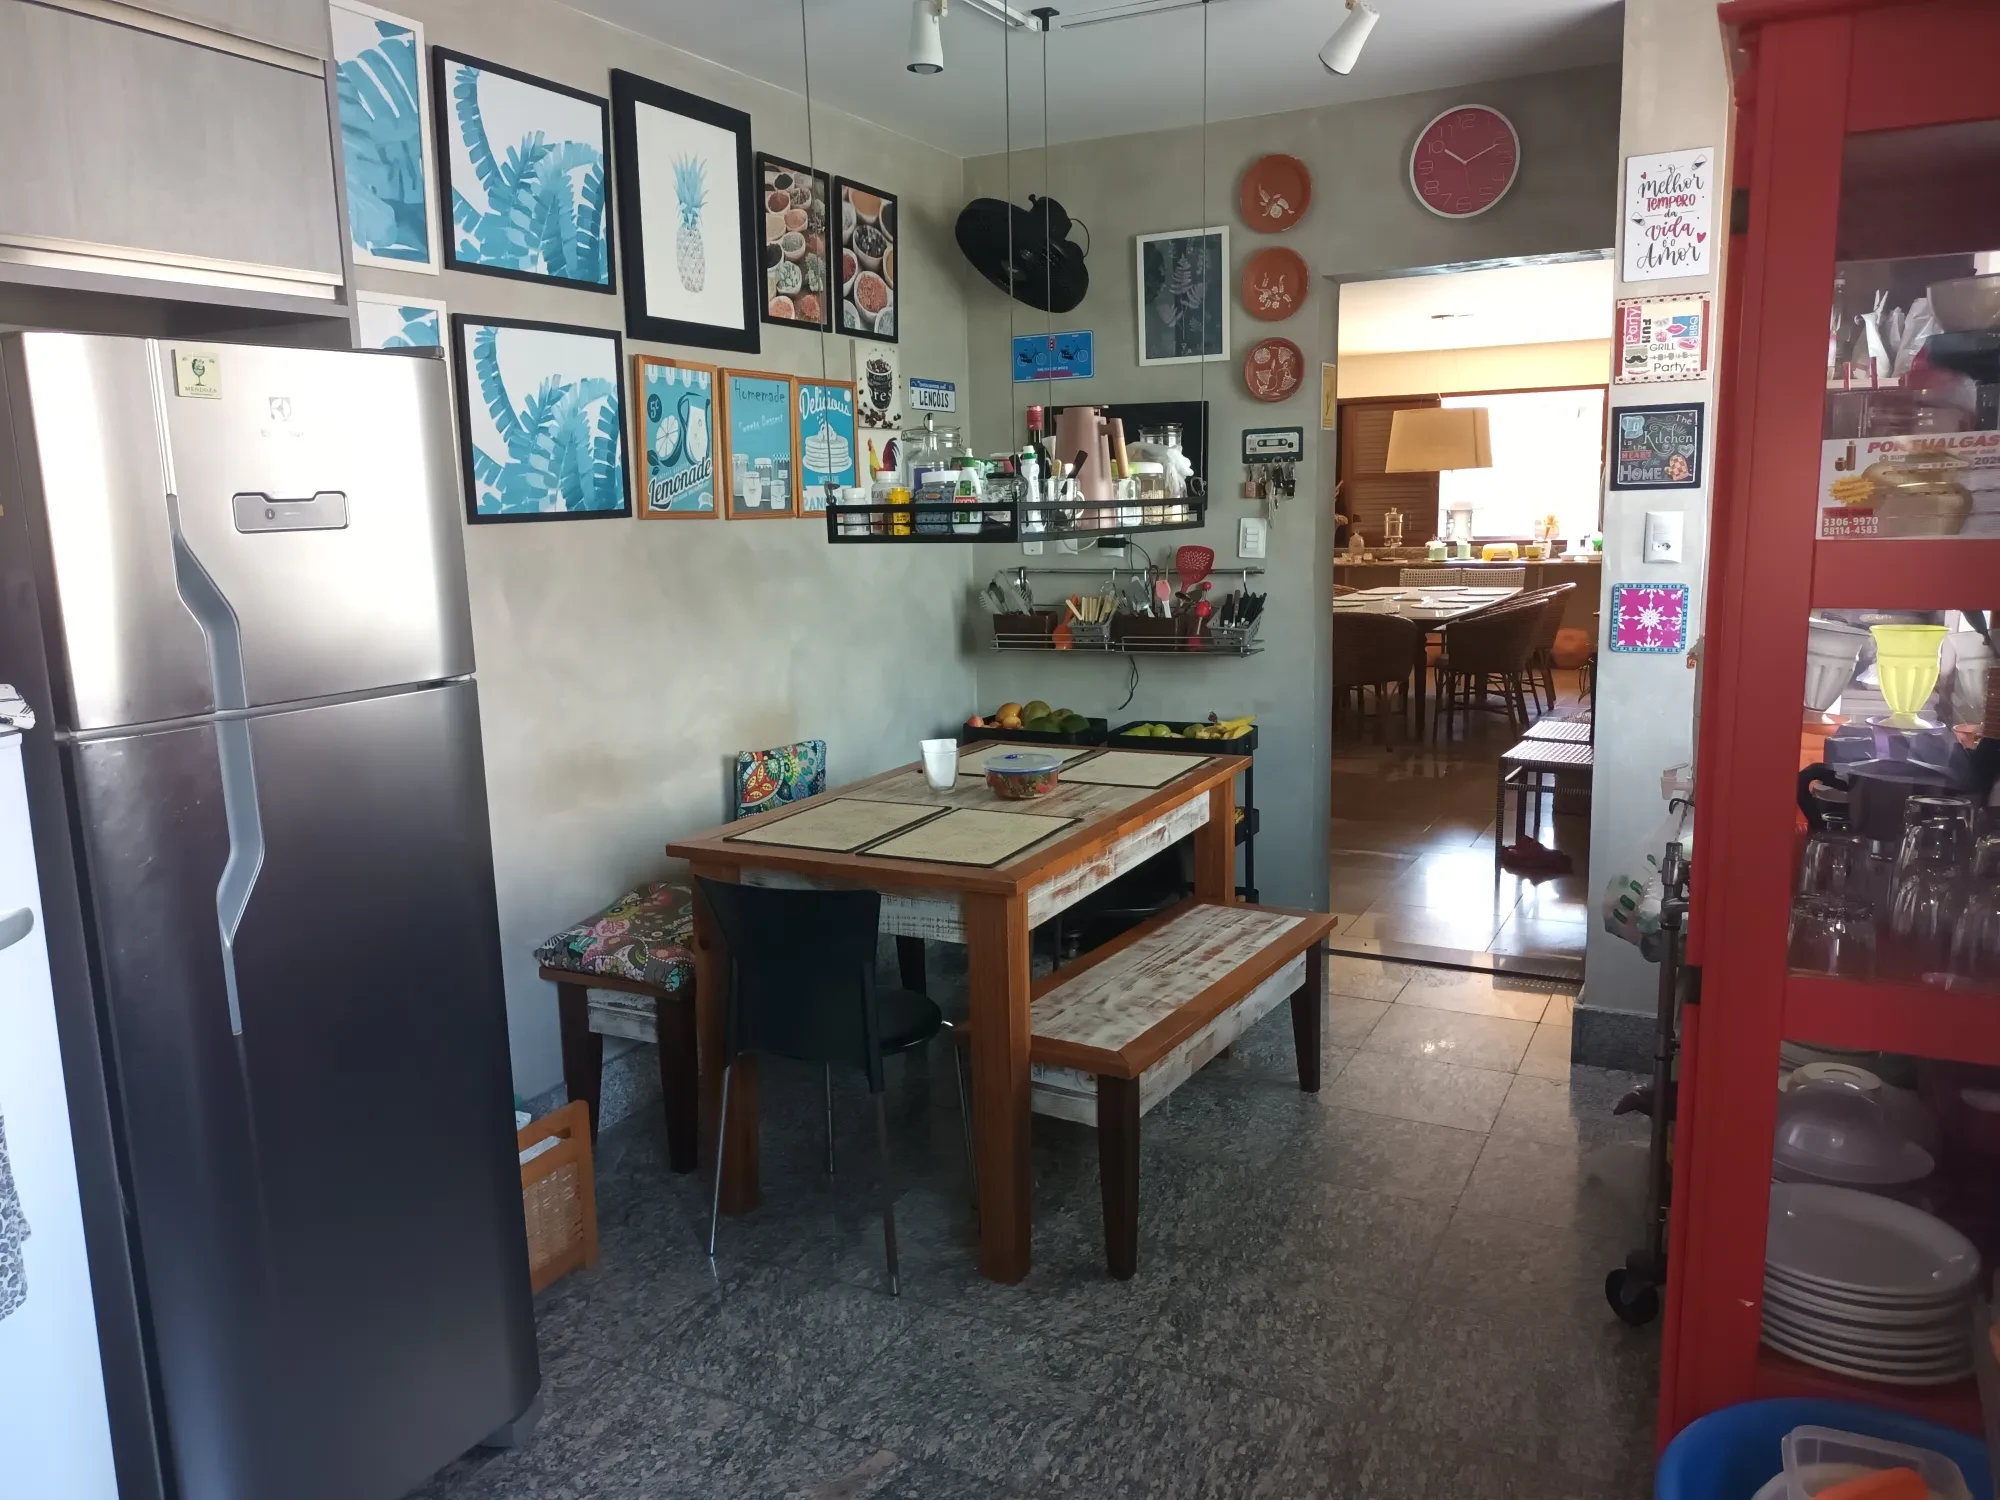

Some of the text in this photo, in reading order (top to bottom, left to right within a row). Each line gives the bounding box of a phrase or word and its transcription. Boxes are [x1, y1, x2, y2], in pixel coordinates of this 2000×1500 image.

[1457, 114, 1476, 128] 12
[1438, 124, 1454, 138] 11
[1426, 140, 1445, 155] 10
[1418, 160, 1434, 175] 9
[1424, 180, 1439, 195] 8
[1441, 193, 1452, 208] 7
[1456, 197, 1472, 212] 6
[1664, 209, 1677, 218] da
[1637, 243, 1701, 269] Amor
[1626, 307, 1641, 344] Party
[1689, 316, 1699, 336] BBQ
[1650, 343, 1676, 352] GRILL
[1654, 362, 1686, 372] Party
[734, 379, 786, 403] Homemade
[800, 386, 852, 420] Delicious
[1676, 414, 1692, 425] The
[1643, 424, 1693, 446] Kitchen
[1620, 465, 1662, 481] HOME
[648, 456, 712, 509] Lemonade
[1823, 517, 1879, 526] 3306-9970
[1823, 526, 1878, 535] 98114-4583
